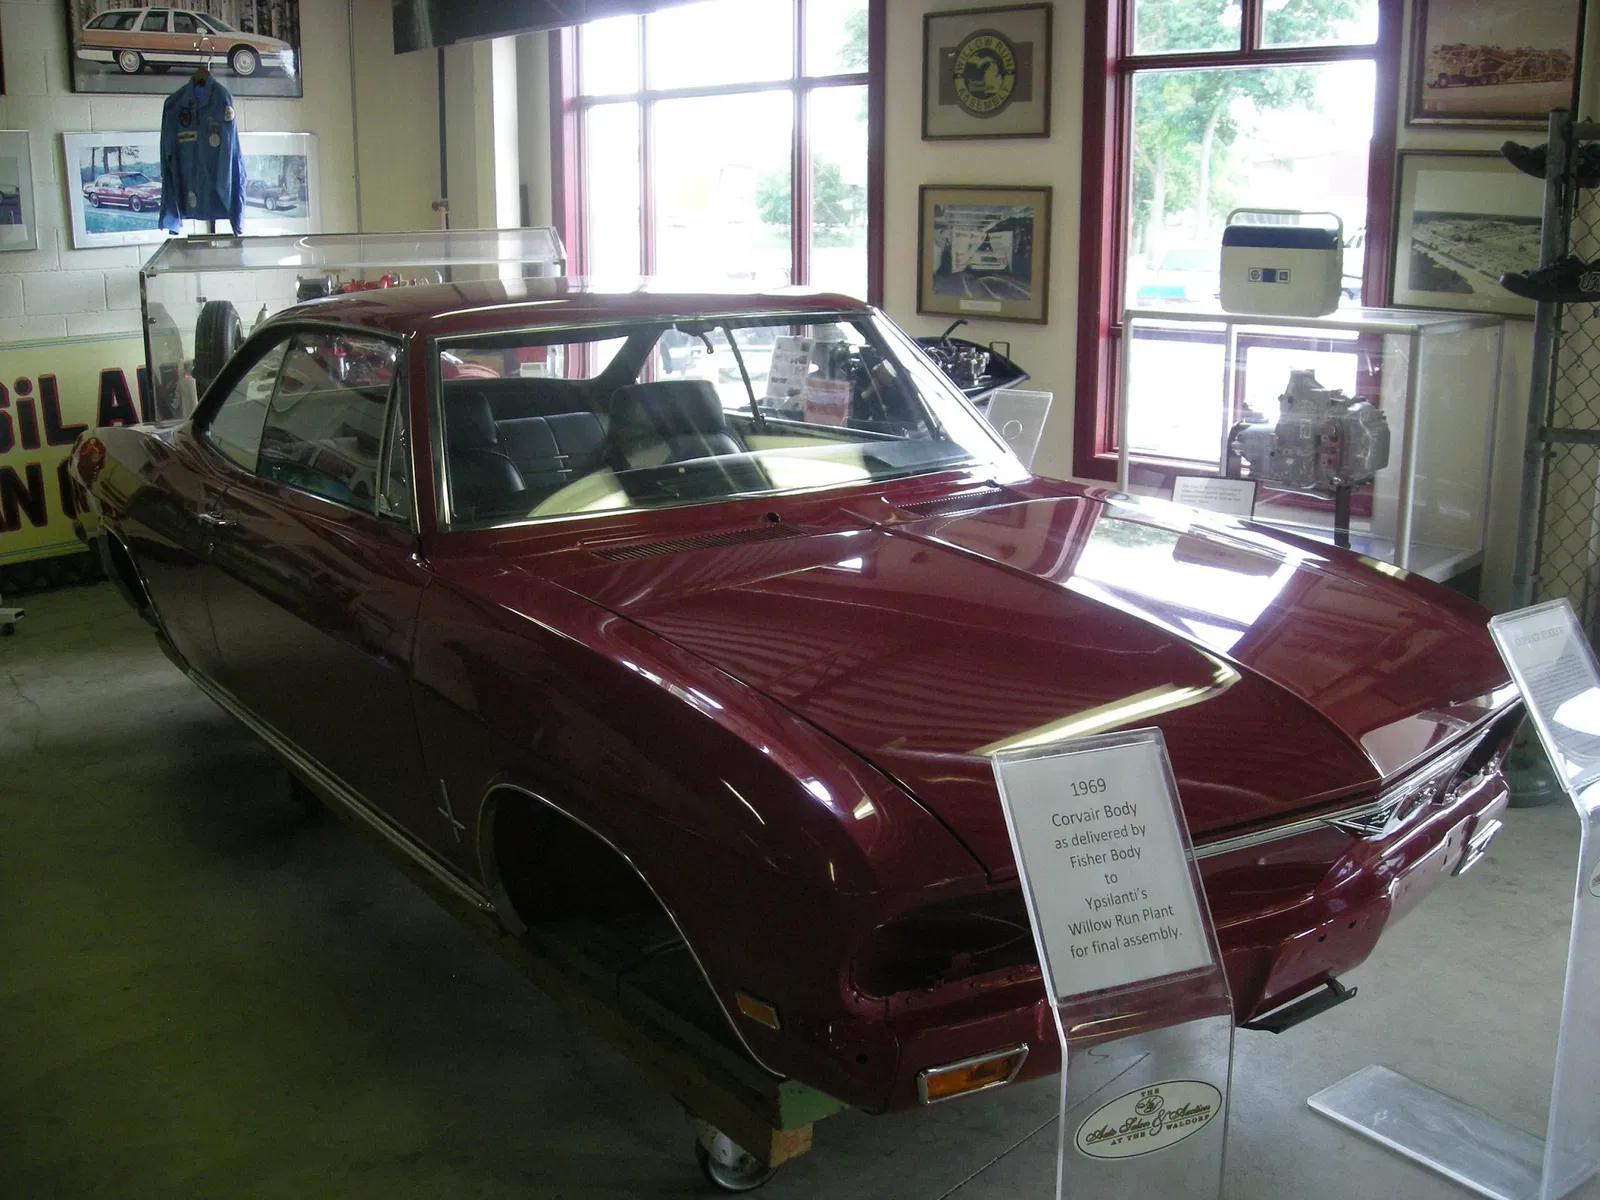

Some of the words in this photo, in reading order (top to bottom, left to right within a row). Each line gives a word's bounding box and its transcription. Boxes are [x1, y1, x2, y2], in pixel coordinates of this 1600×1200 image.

[956, 36, 993, 72] WILLOW
[994, 41, 1015, 70] RUN
[956, 86, 1009, 110] ASSEMBLY
[1070, 777, 1107, 797] 1969
[1051, 807, 1101, 828] Corvair
[1103, 801, 1138, 819] Body
[1054, 838, 1069, 850] as
[1071, 825, 1129, 847] delivered
[1131, 823, 1147, 839] by
[1069, 850, 1107, 869] Fisher
[1110, 845, 1142, 862] Body
[1104, 872, 1118, 885] to
[1084, 887, 1148, 912] Ypsilanti's
[1068, 917, 1112, 936] Willow
[1115, 913, 1140, 931] Run
[1142, 904, 1175, 922] Plant
[1069, 944, 1089, 959] for
[1091, 936, 1120, 954] final
[1123, 925, 1183, 949] assembly.
[1140, 1087, 1160, 1098] THE
[1085, 1123, 1118, 1143] Auto
[1148, 1108, 1170, 1137] &
[1110, 1137, 1123, 1146] AT
[1126, 1131, 1146, 1142] THE
[1166, 1114, 1210, 1131] WALDORF
